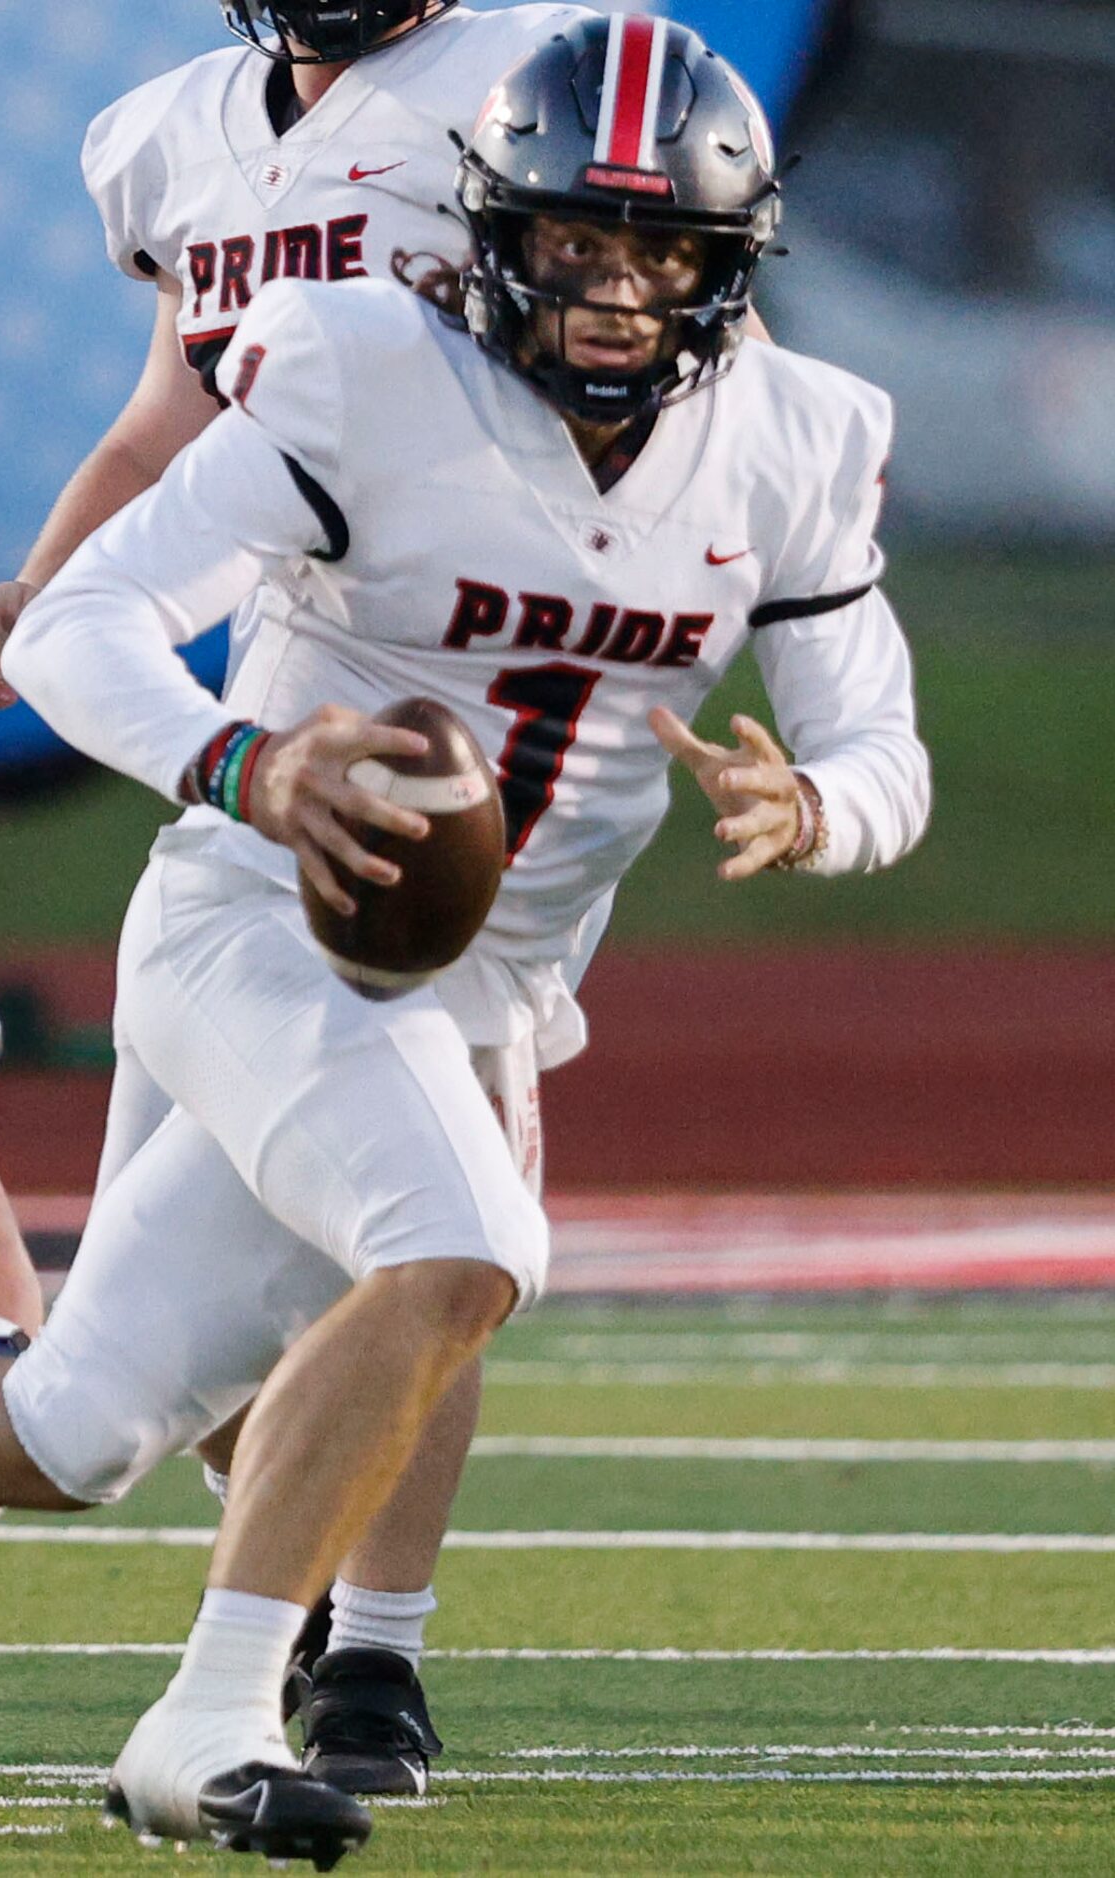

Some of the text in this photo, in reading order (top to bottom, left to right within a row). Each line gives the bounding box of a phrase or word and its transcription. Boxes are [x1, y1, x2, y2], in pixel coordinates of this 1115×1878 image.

[186, 213, 370, 319] PRIDE
[440, 577, 715, 667] PRIDE
[486, 660, 603, 870] 1
